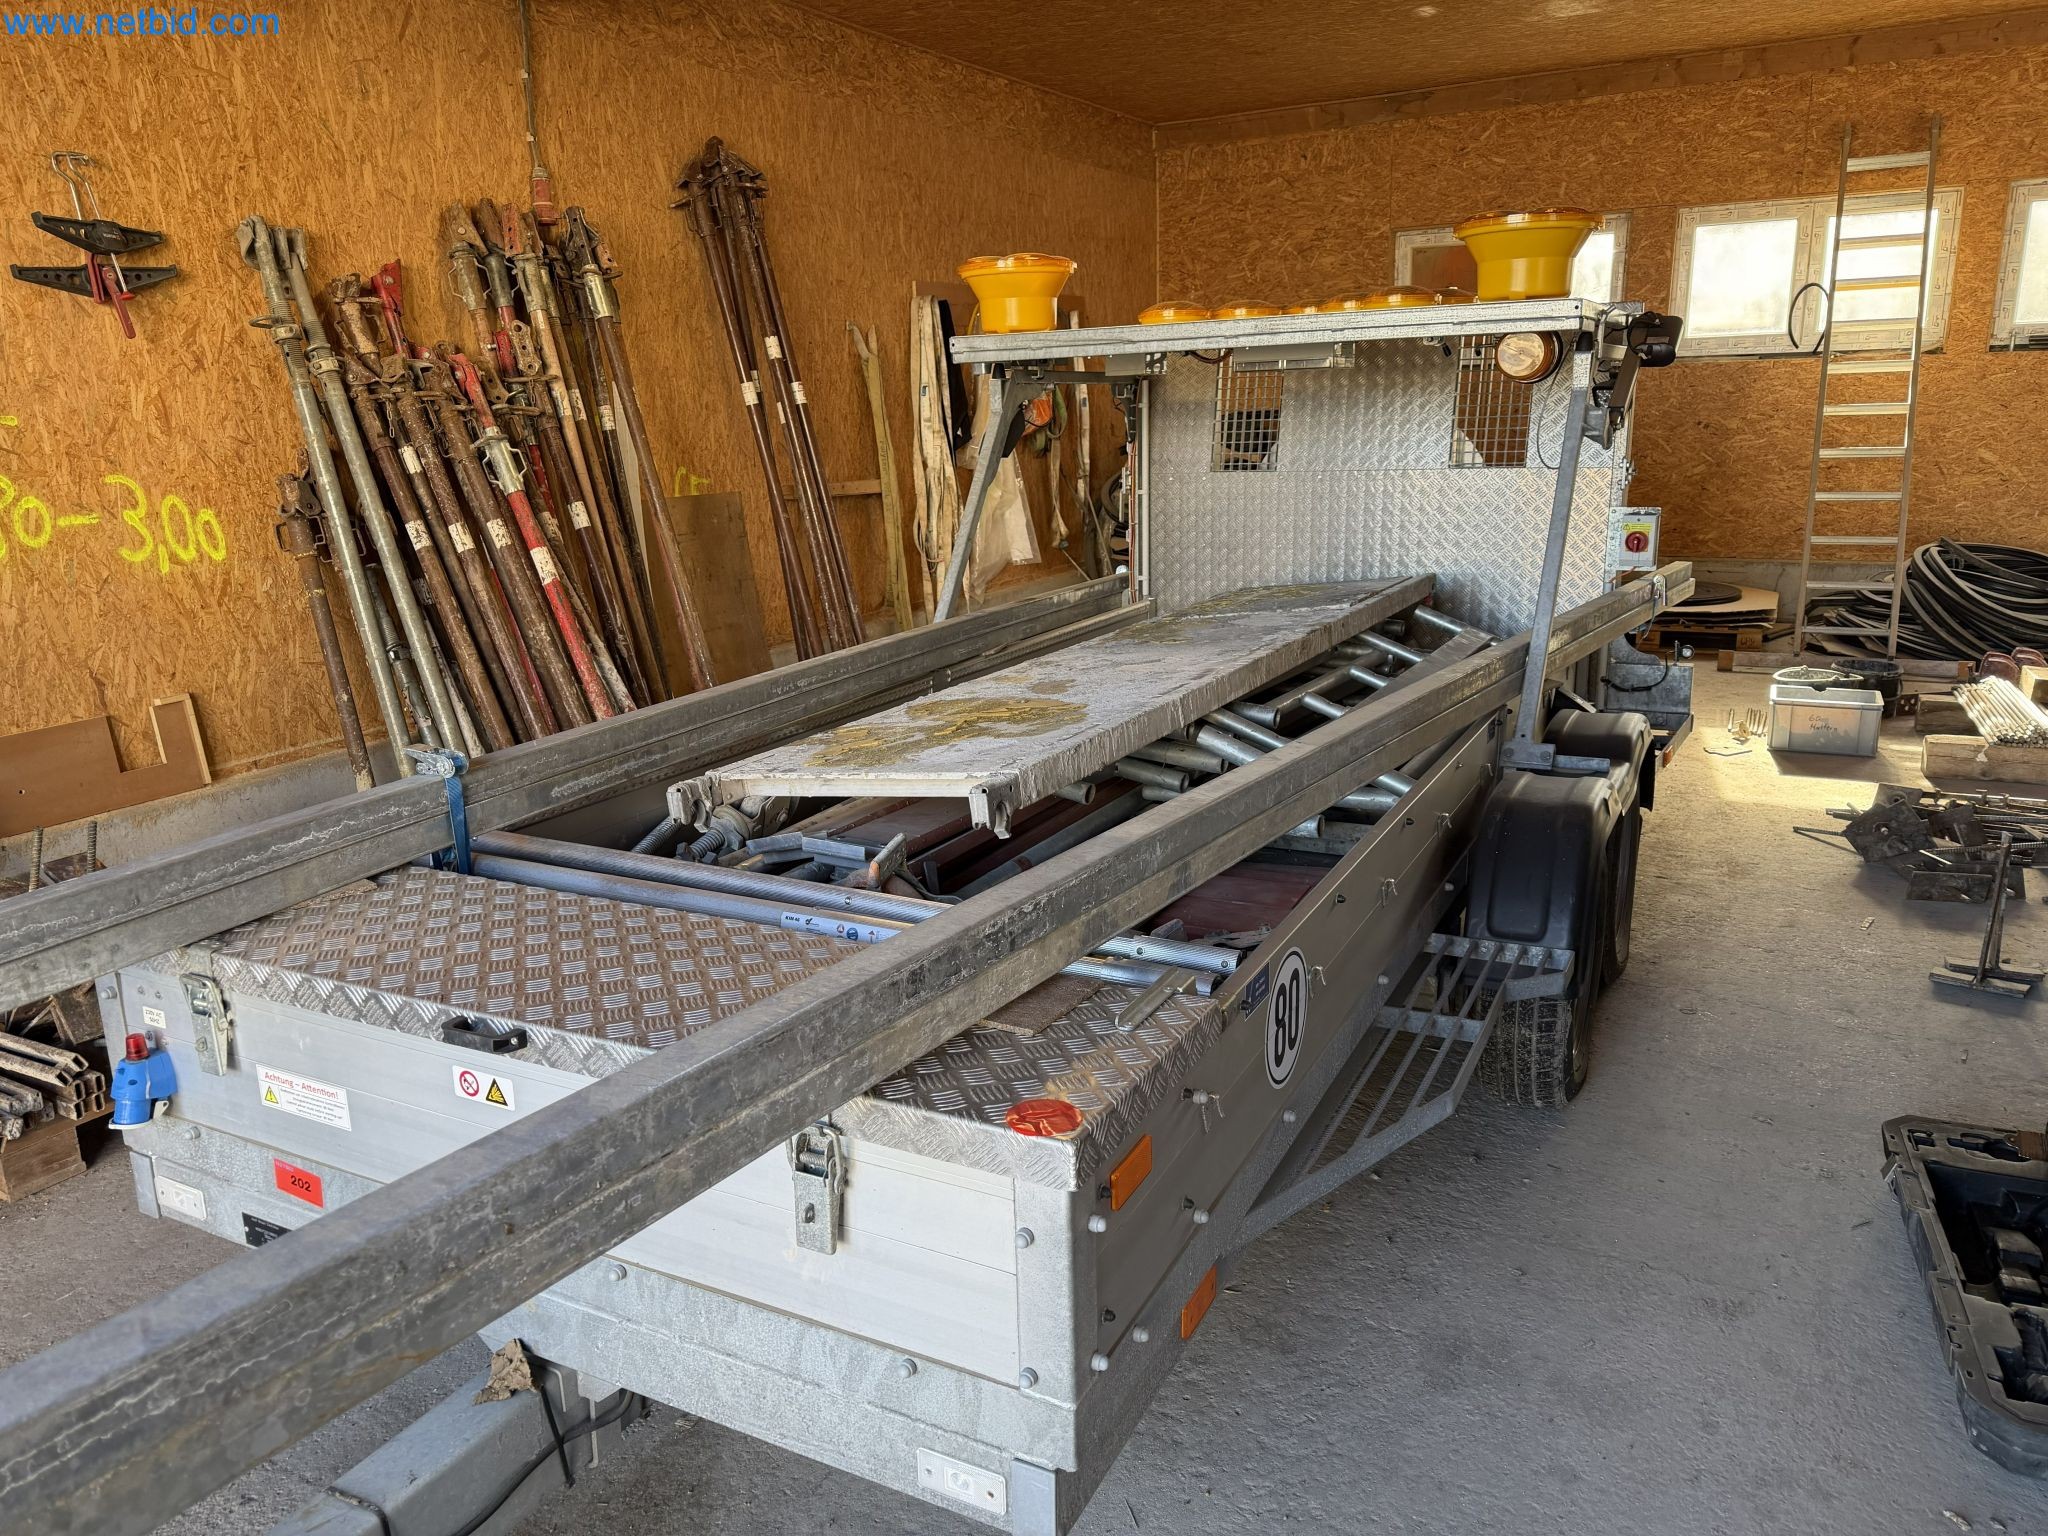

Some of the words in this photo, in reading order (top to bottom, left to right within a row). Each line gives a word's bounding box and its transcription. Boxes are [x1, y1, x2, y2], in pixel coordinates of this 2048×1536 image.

[1275, 968, 1300, 1068] 80
[265, 1072, 294, 1088] Achtung
[302, 1083, 339, 1100] Attention!
[291, 1175, 312, 1193] 202
